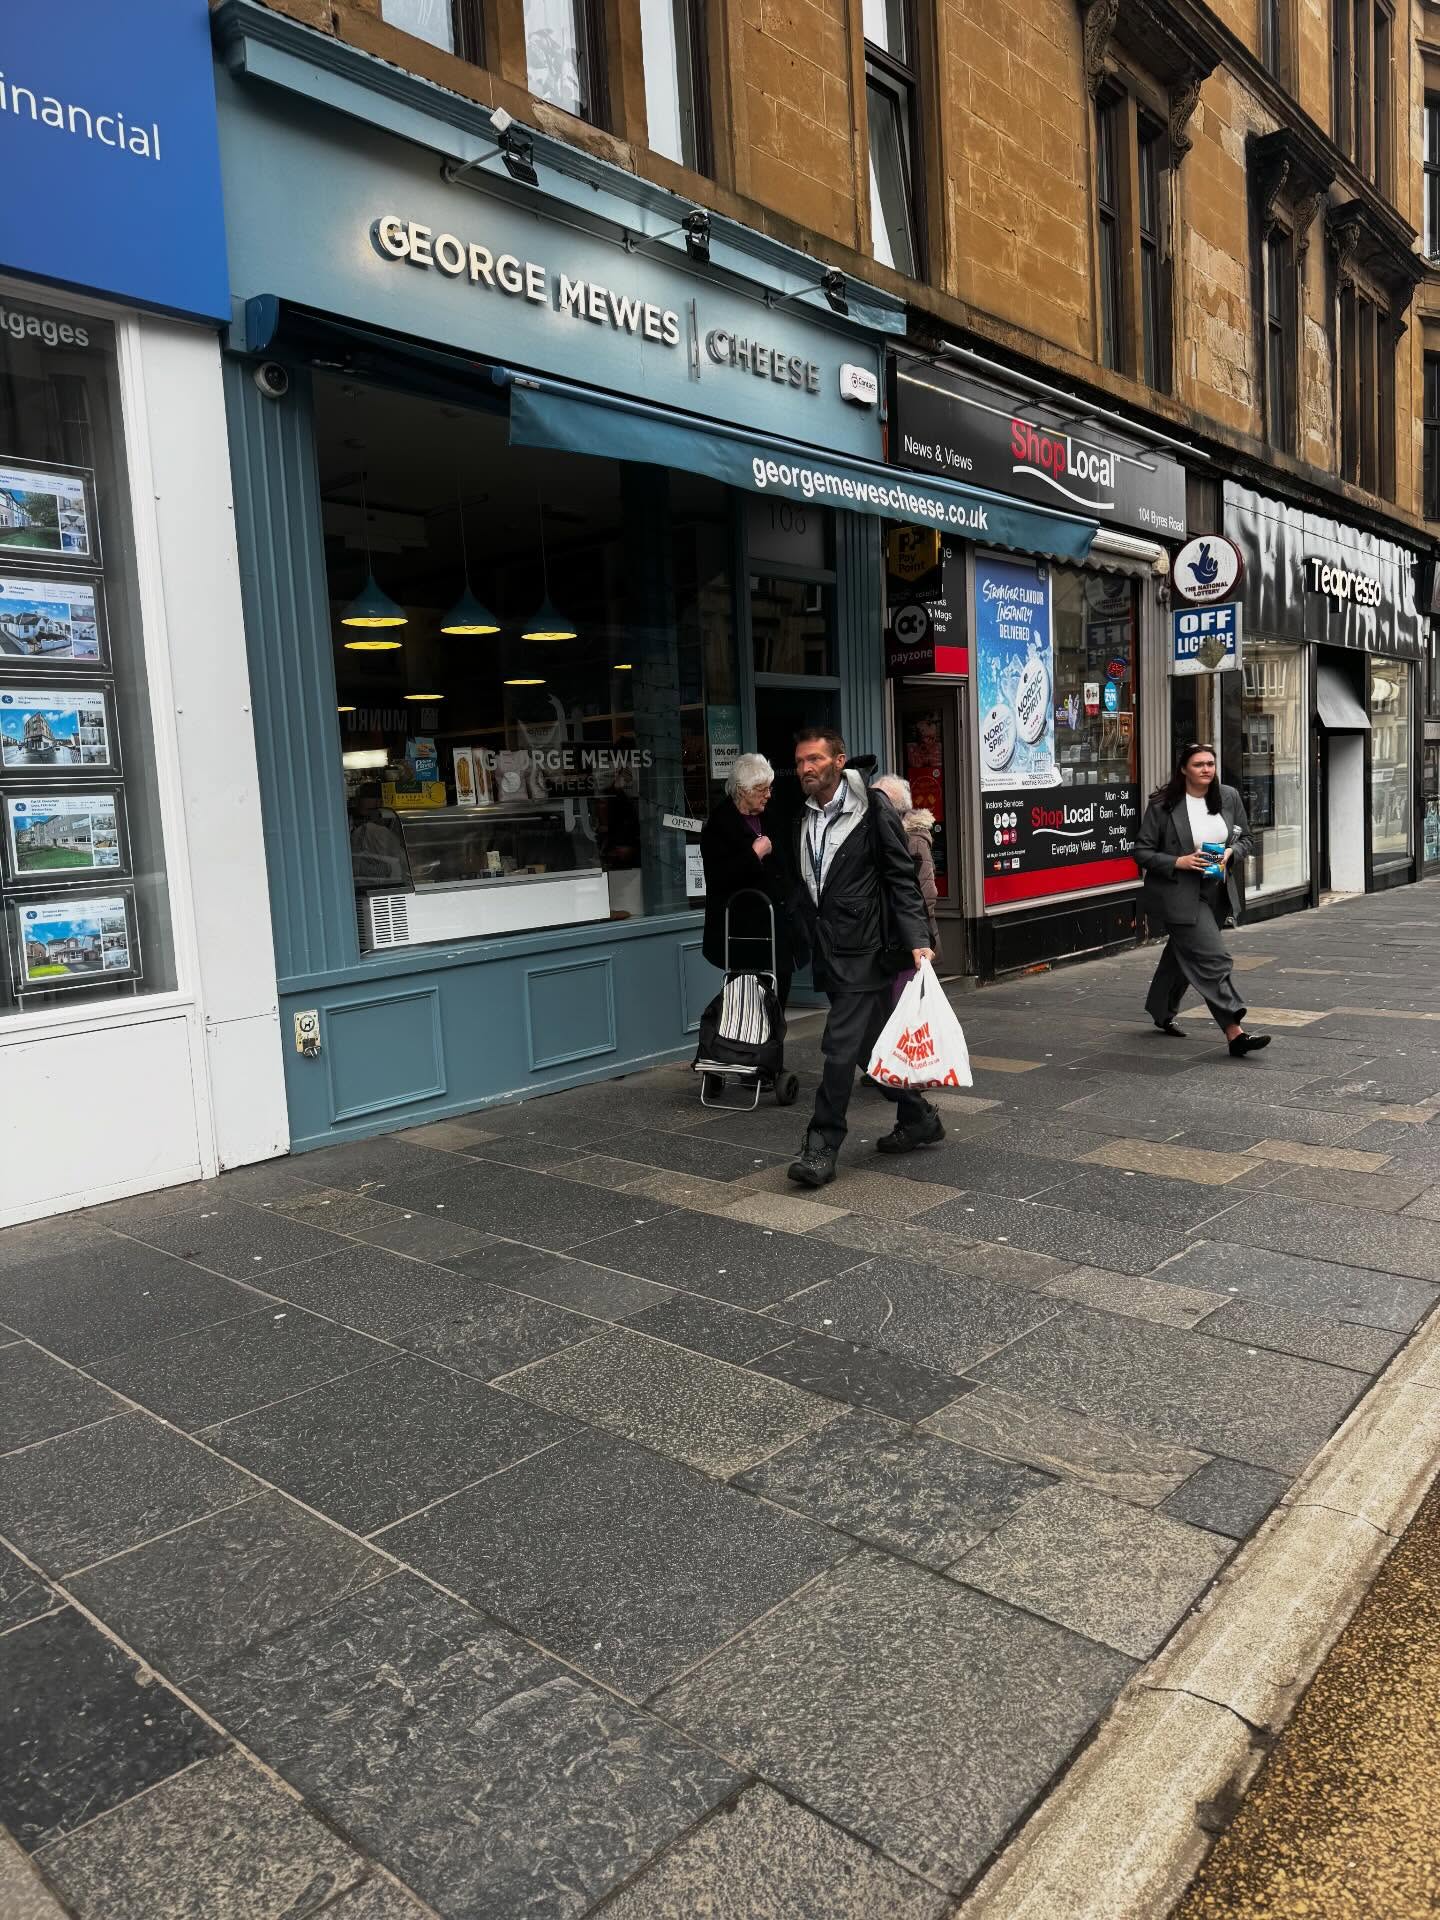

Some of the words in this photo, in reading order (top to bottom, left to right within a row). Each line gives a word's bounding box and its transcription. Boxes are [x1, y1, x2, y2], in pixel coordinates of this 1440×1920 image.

[374, 215, 548, 304] GEORGE
[558, 272, 680, 345] MEWES
[706, 328, 821, 394] CHEESE
[903, 434, 934, 460] News
[934, 444, 943, 463] &
[944, 447, 973, 471] Views
[752, 456, 989, 531] georgemewescheese.co.uk
[1138, 507, 1150, 522] 104
[1151, 510, 1168, 529] Byres
[1168, 518, 1184, 533] Road
[1184, 586, 1197, 594] THE
[1197, 581, 1229, 592] NATIONAL
[1193, 588, 1220, 597] LOTTERY
[1019, 588, 1044, 605] FLAVOUR
[934, 608, 953, 622] Mags
[1179, 609, 1232, 634] OFF
[999, 625, 1030, 642] DELIVERED
[1177, 632, 1234, 654] LICECE
[890, 648, 933, 665] payzone
[1016, 669, 1043, 718] NORDIC
[1022, 688, 1043, 725] SPIRIT
[581, 748, 653, 769] MEWES
[985, 801, 1003, 809] Instore
[1003, 799, 1025, 808] Services
[1105, 791, 1117, 801] Mon
[1120, 790, 1130, 800] Sat
[1099, 806, 1114, 819] 6am
[1119, 803, 1136, 817] 10pm
[671, 817, 695, 829] OPEN
[1108, 826, 1127, 836] Sunday
[1051, 843, 1080, 856] Everyday
[1080, 840, 1097, 852] Value
[1100, 840, 1114, 854] 7am
[871, 1057, 960, 1089] Icelnd
